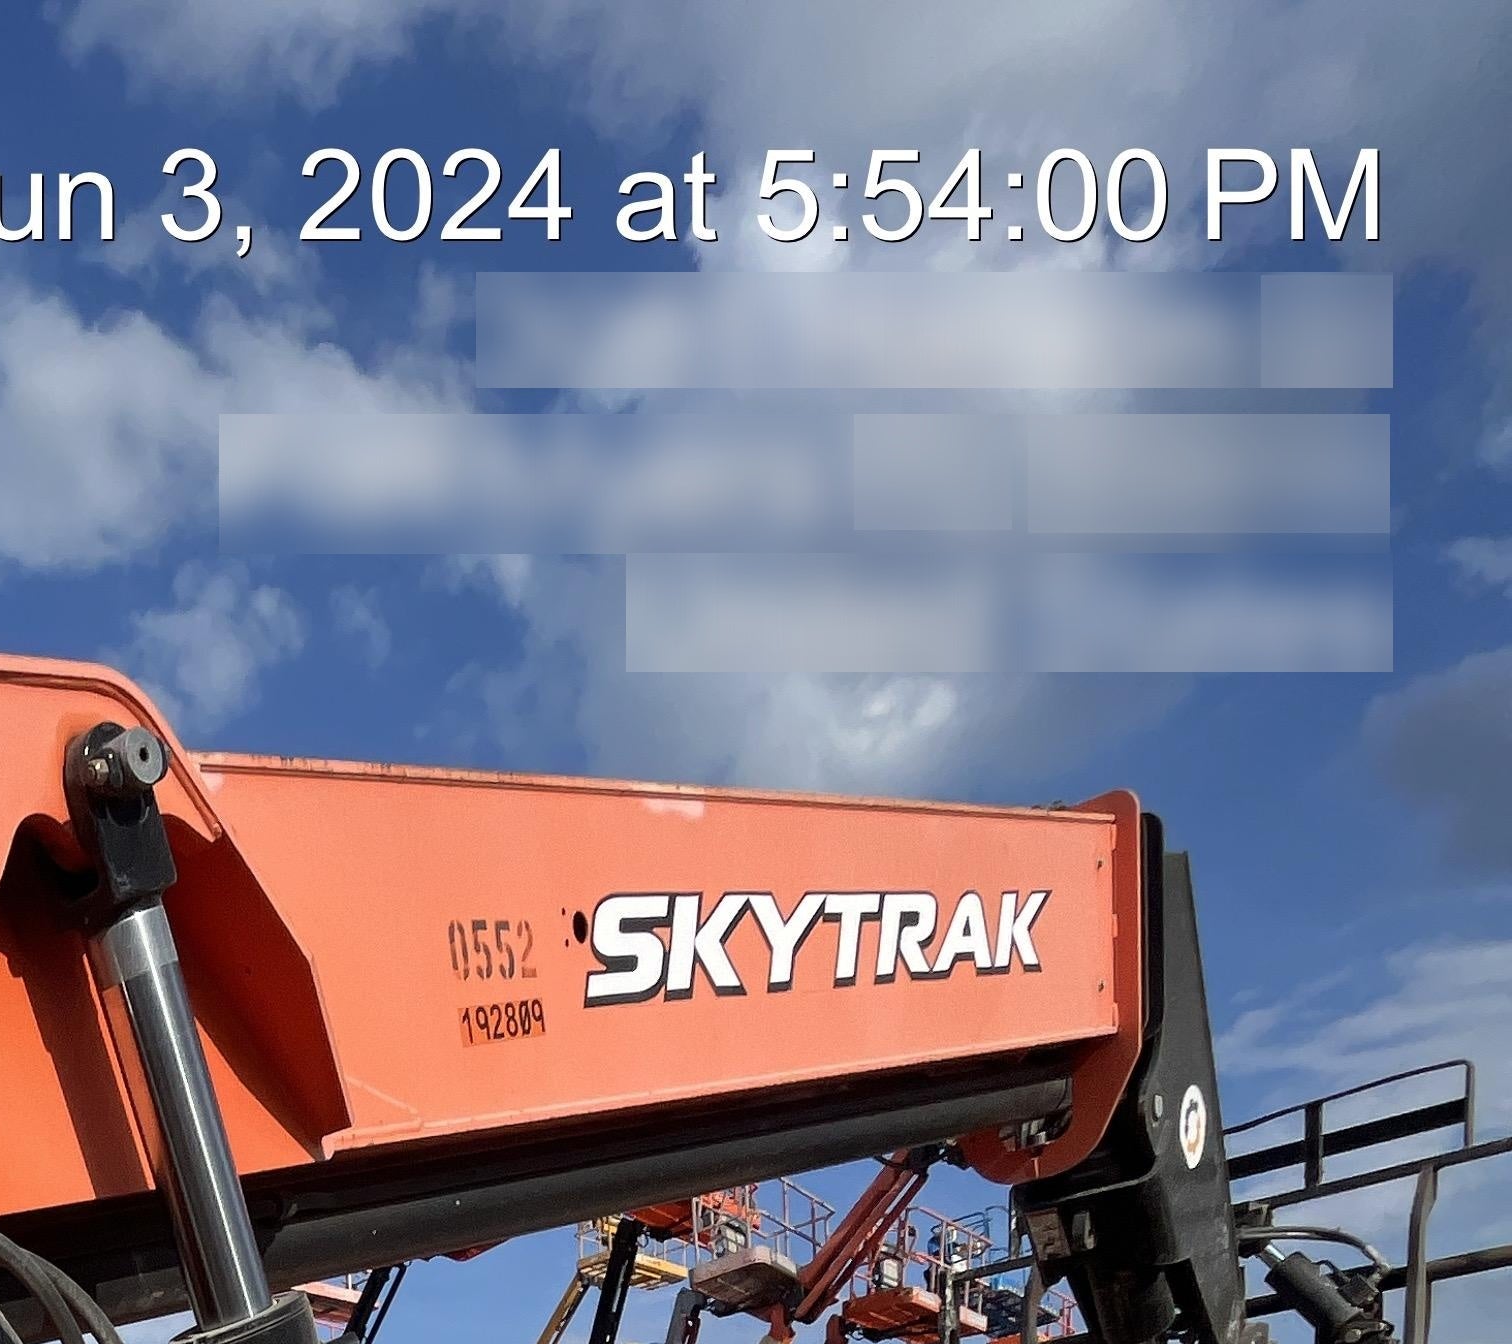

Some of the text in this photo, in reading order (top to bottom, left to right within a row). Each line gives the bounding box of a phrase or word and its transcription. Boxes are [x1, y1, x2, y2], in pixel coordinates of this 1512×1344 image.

[449, 919, 538, 981] 0552
[583, 890, 1052, 1008] SKYTRAK
[462, 999, 546, 1044] 192809
